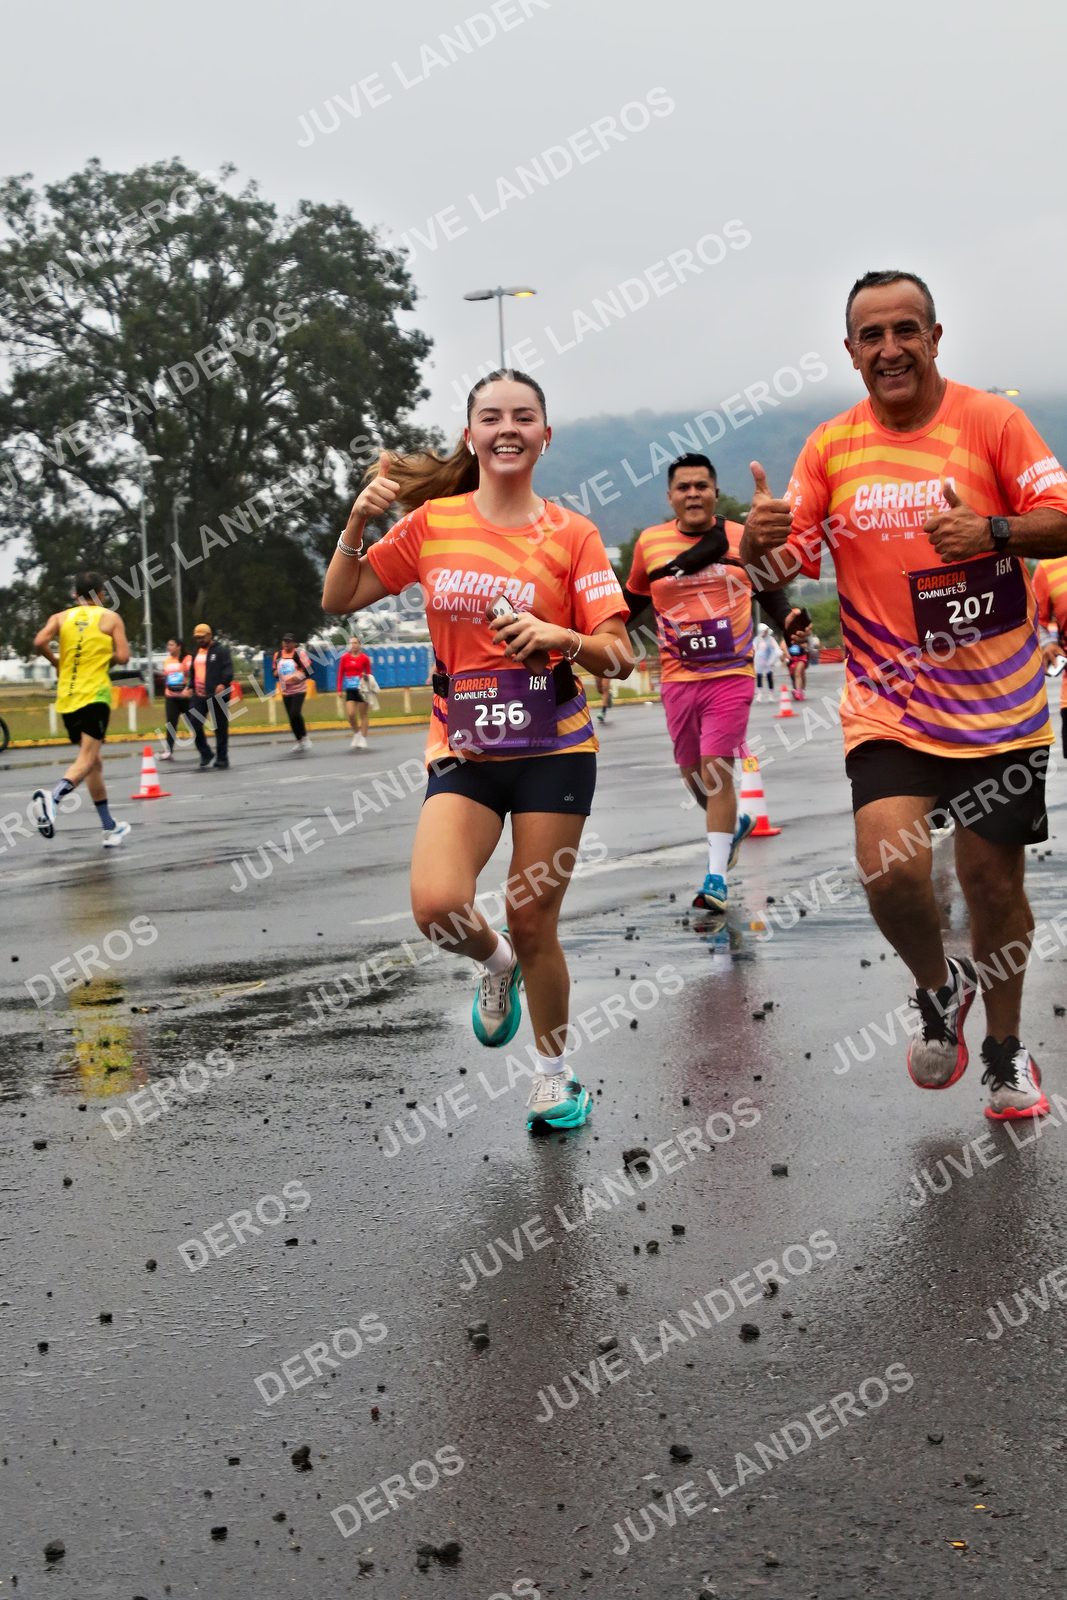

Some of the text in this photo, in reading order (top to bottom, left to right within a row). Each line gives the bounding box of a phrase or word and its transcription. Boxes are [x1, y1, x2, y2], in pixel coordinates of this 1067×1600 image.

[994, 556, 1014, 577] 15K
[434, 568, 536, 605] CARRERA
[917, 570, 967, 591] CARRERA
[918, 586, 957, 601] OMNILIFE
[432, 595, 490, 615] OMNILI
[946, 591, 995, 624] 207
[689, 635, 717, 650] 613
[454, 677, 498, 692] CARRERA
[454, 691, 488, 701] OMNILIFE
[474, 702, 525, 727] 256
